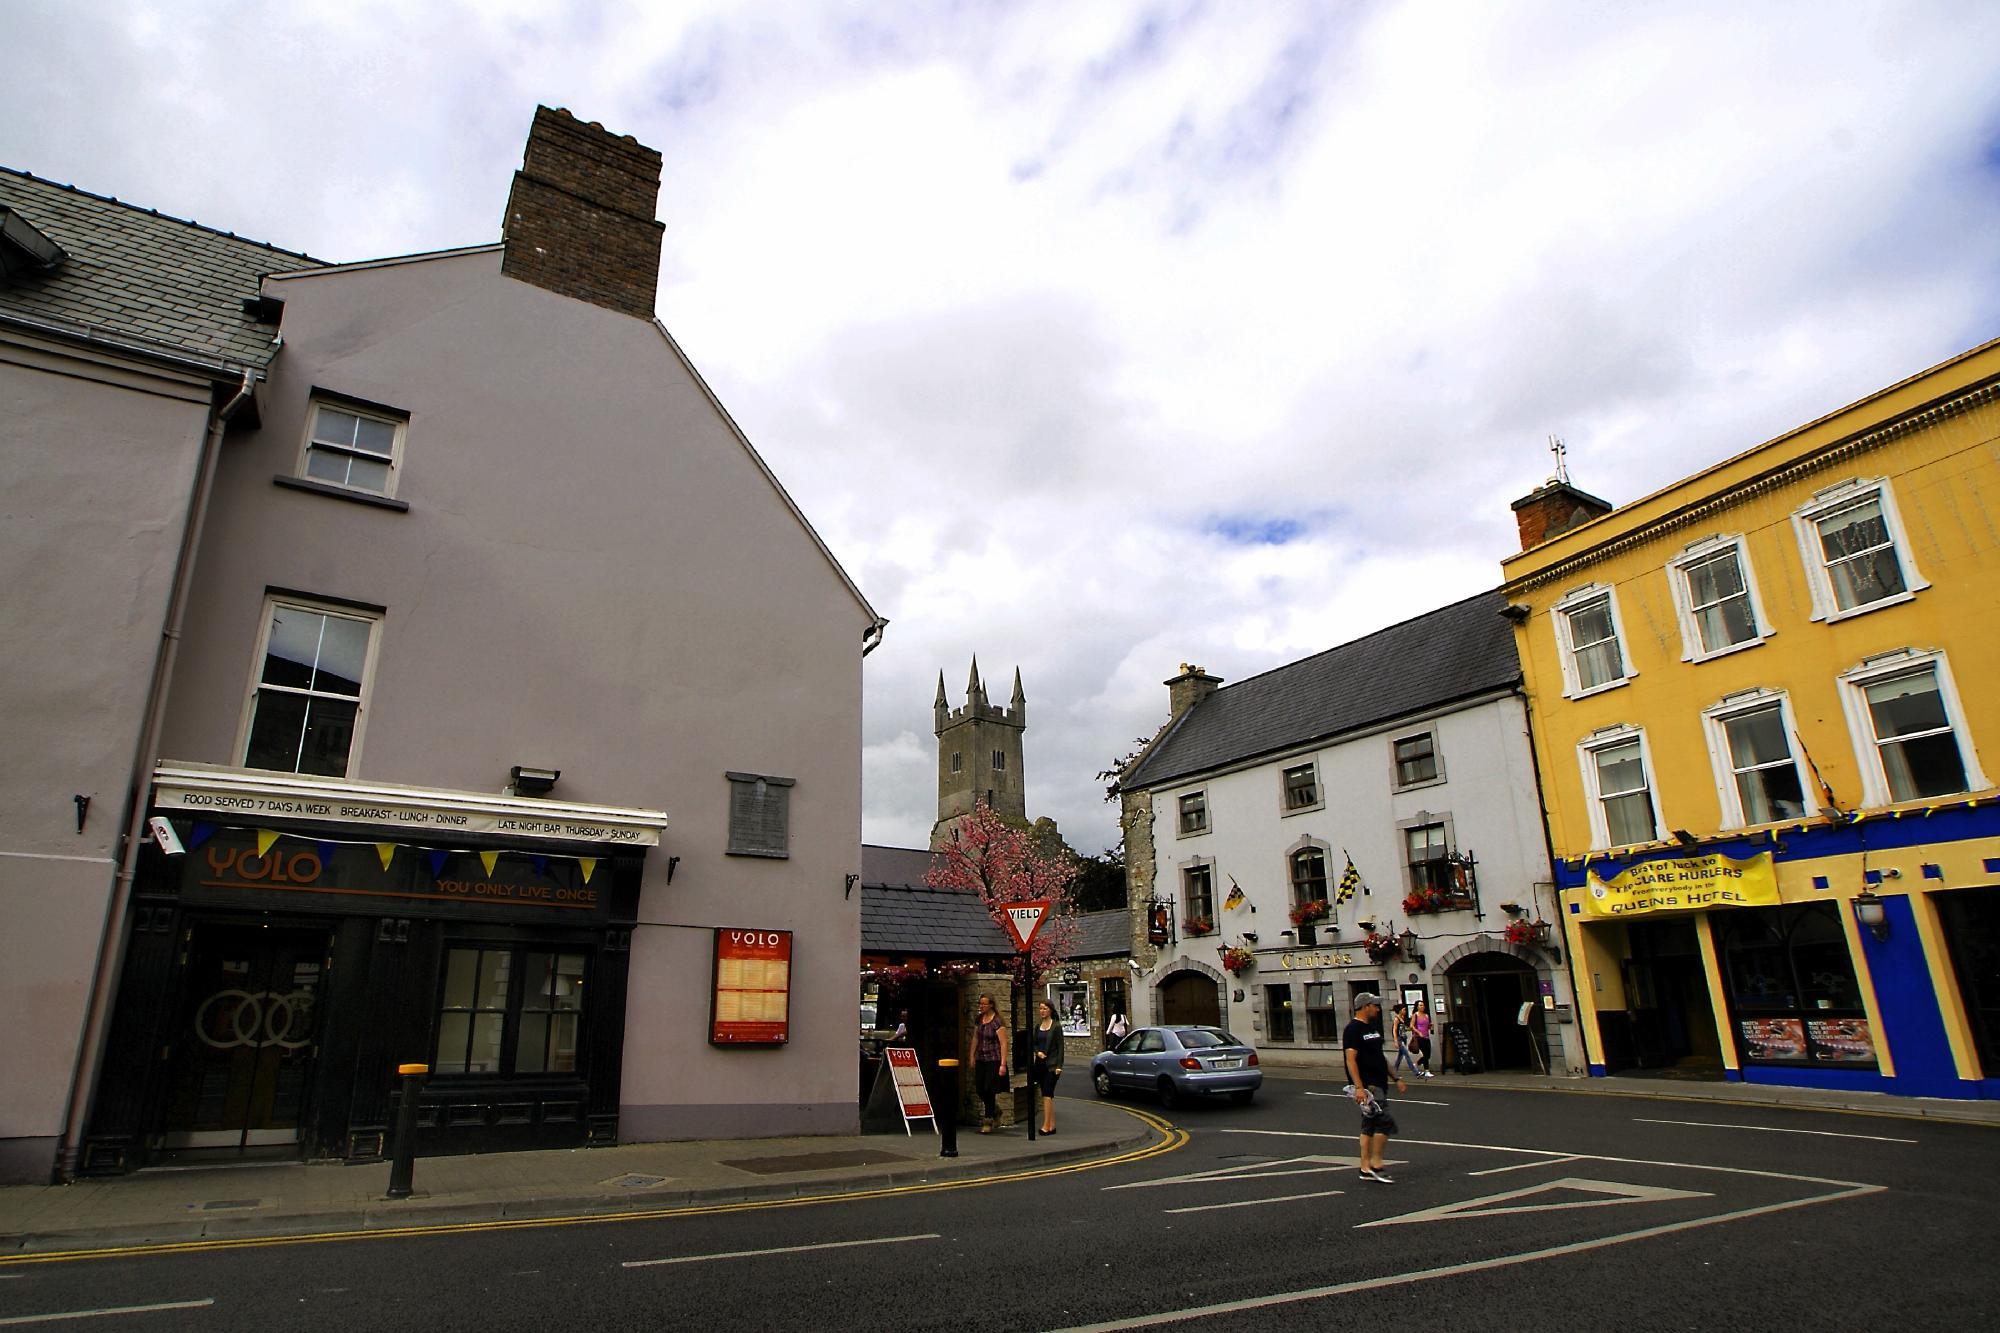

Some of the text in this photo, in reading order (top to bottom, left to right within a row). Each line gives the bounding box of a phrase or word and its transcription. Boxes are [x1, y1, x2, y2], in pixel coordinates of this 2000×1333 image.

[183, 793, 331, 815] FOOD SERVED 7 DAYS A WEEK
[340, 806, 392, 819] BREAKFAST
[399, 811, 429, 822] LUNCH
[436, 814, 468, 825] DINNER
[498, 820, 517, 830] LATE
[518, 822, 543, 832] NIGHT
[543, 824, 561, 833] BAR
[565, 825, 605, 837] THURSDAY
[610, 829, 641, 840] SUNDAY
[207, 847, 322, 883] YOLO
[1656, 862, 1668, 871] of
[1671, 860, 1700, 869] luck
[1701, 858, 1716, 866] to
[1634, 873, 1675, 886] CLARE
[1679, 867, 1743, 881] HURLERS
[436, 879, 598, 901] YOU ONLY LIVE ONCE
[1687, 890, 1747, 904] HOTEL
[1009, 908, 1040, 919] YIELD
[731, 931, 779, 946] YOLO
[1281, 951, 1352, 969] Cruises
[891, 1050, 911, 1059] YOLO
